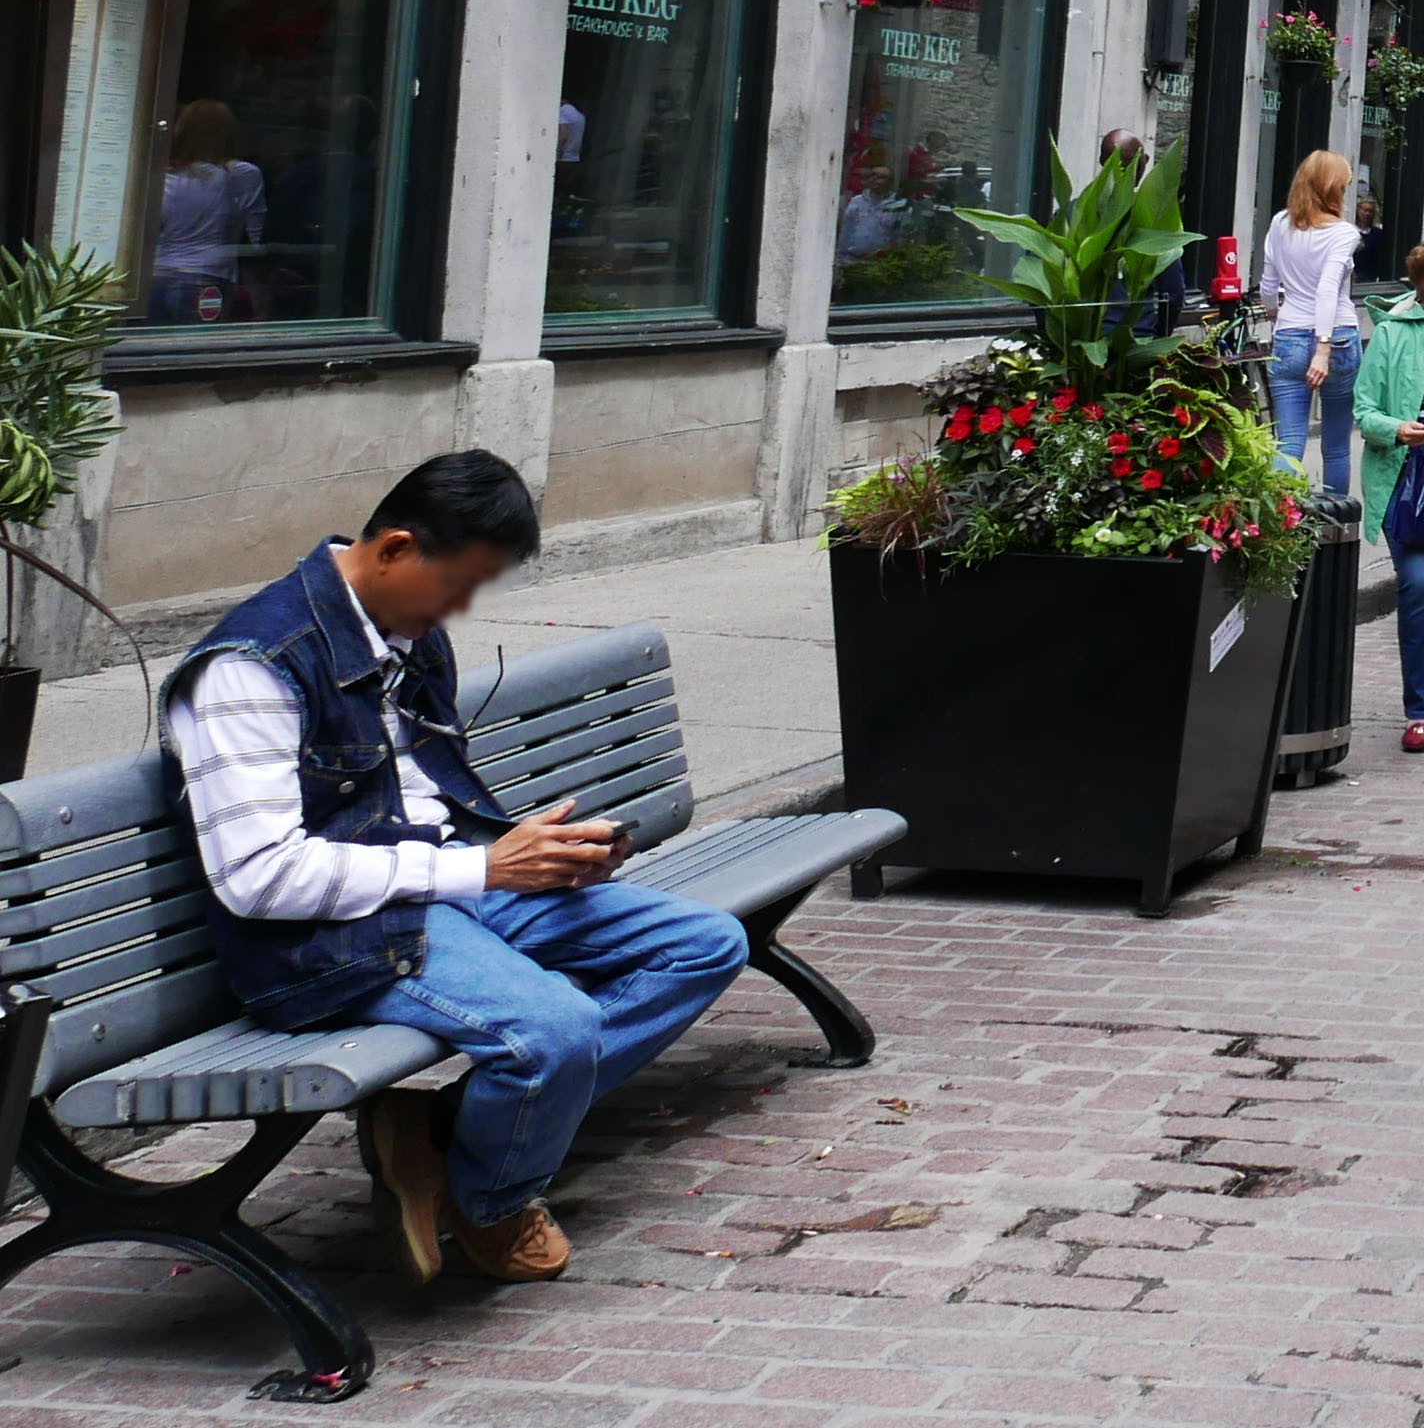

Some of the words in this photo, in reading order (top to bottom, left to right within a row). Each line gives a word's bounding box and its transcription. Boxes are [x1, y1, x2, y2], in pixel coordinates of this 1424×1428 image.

[646, 25, 669, 44] BAR
[881, 28, 920, 60] THE
[922, 34, 961, 66] KEG
